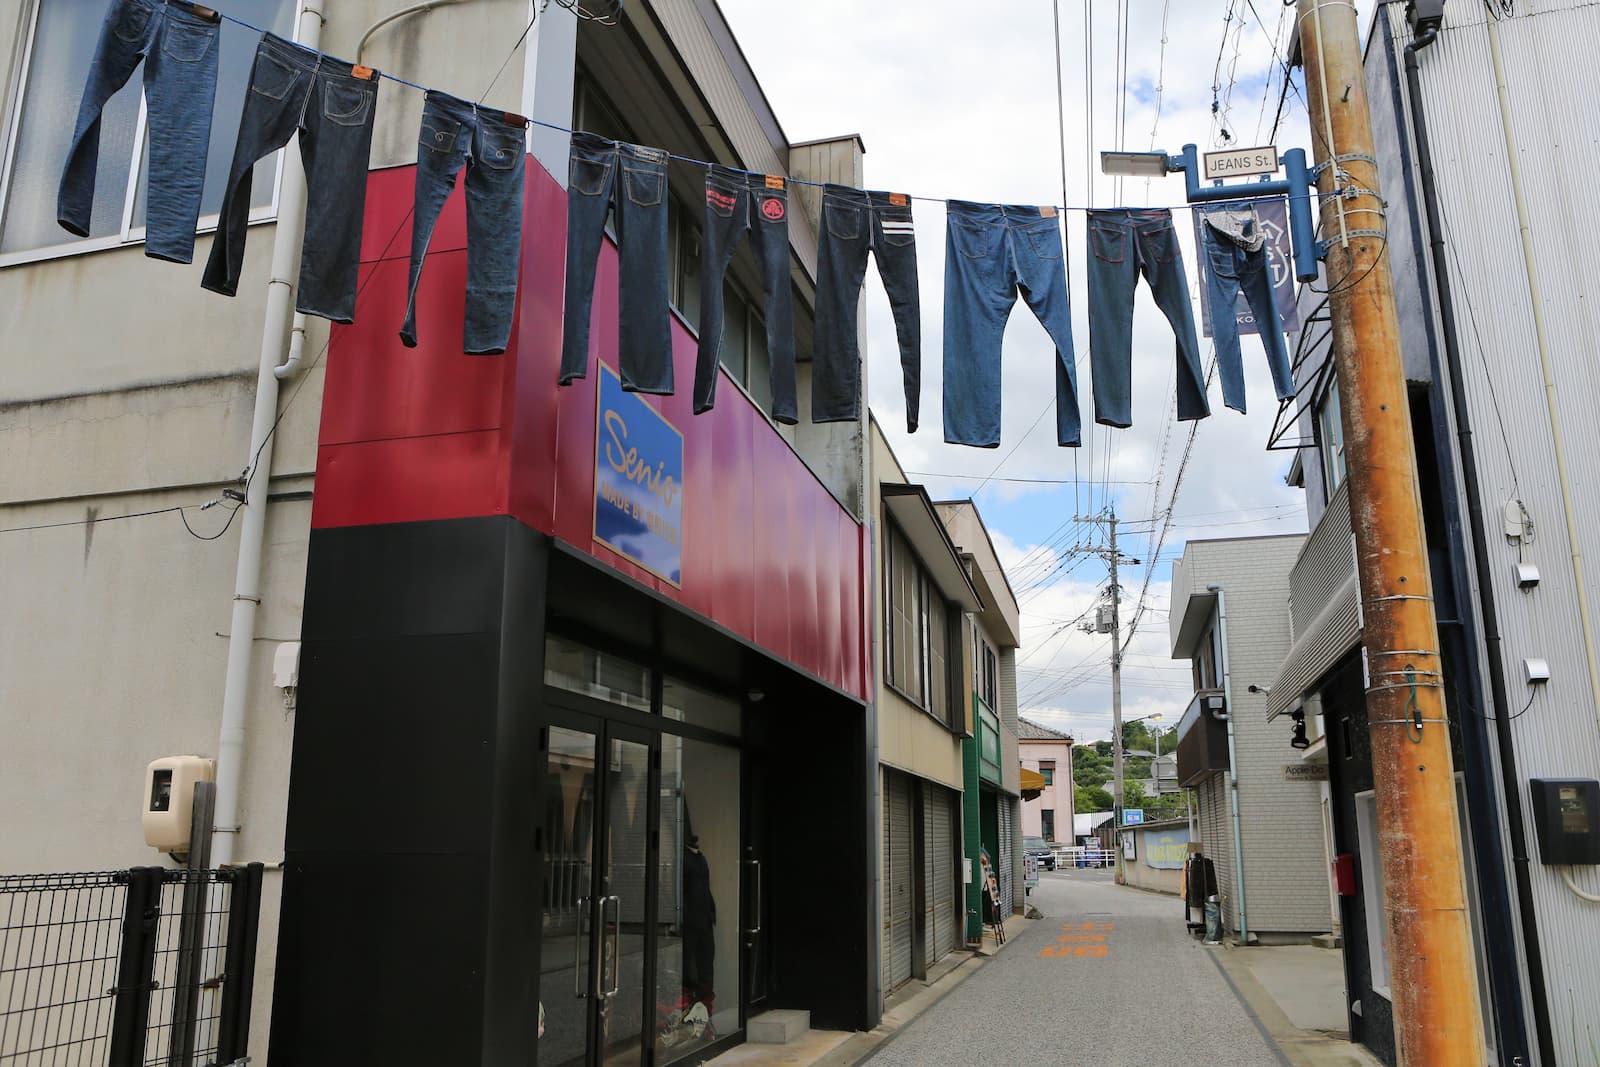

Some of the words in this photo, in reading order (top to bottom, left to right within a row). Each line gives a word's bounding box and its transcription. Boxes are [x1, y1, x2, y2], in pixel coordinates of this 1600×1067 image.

[1210, 157, 1251, 171] JEANS
[1255, 155, 1272, 167] St.
[602, 481, 630, 514] MADE
